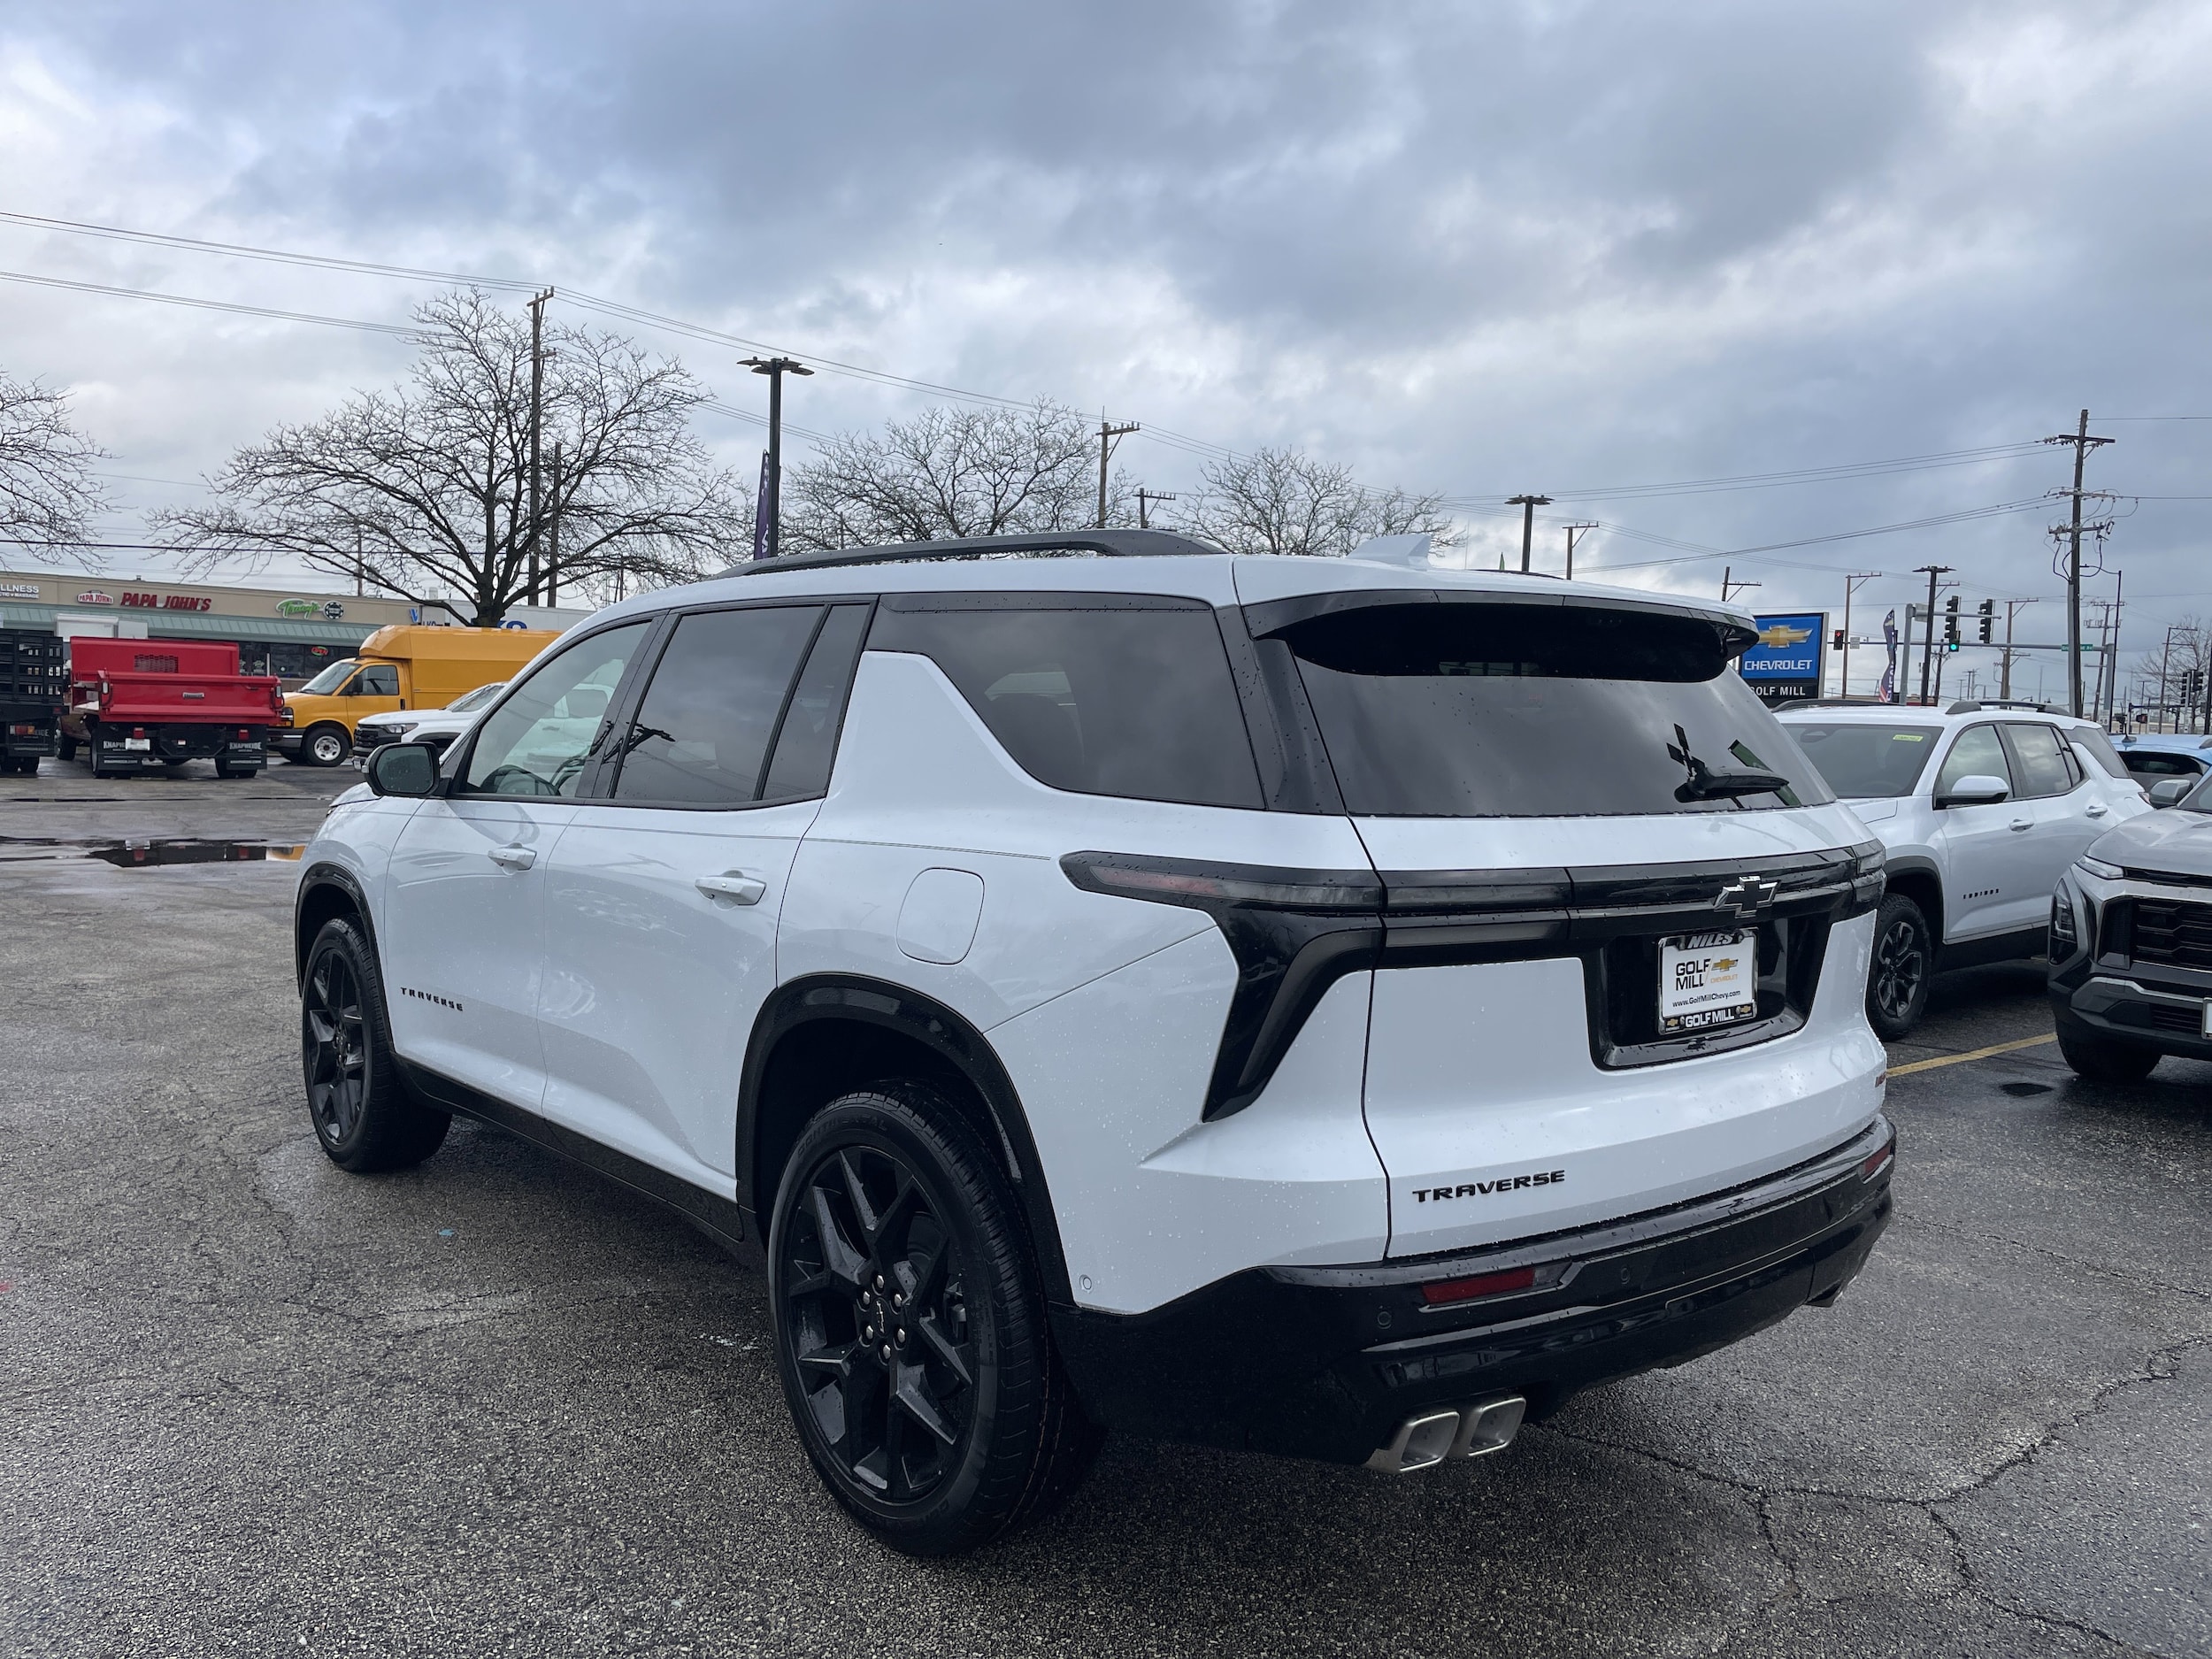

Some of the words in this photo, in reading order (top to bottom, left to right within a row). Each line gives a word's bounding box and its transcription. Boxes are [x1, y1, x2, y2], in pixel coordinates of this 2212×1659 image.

[120, 592, 158, 608] PAPA
[163, 595, 211, 611] JOHN'S
[1744, 659, 1813, 671] CHEVROLET
[1779, 686, 1806, 696] MILL
[1686, 933, 1734, 949] NILES
[1676, 958, 1711, 976] GOLF
[1676, 974, 1704, 991] MILL
[400, 987, 463, 1011] TRAVERSE
[1672, 990, 1741, 1007] www.GolfMillChevy.com
[1685, 1012, 1711, 1028] GOLF
[1712, 1009, 1735, 1024] MILL
[1412, 1170, 1565, 1202] TRAVERSE
